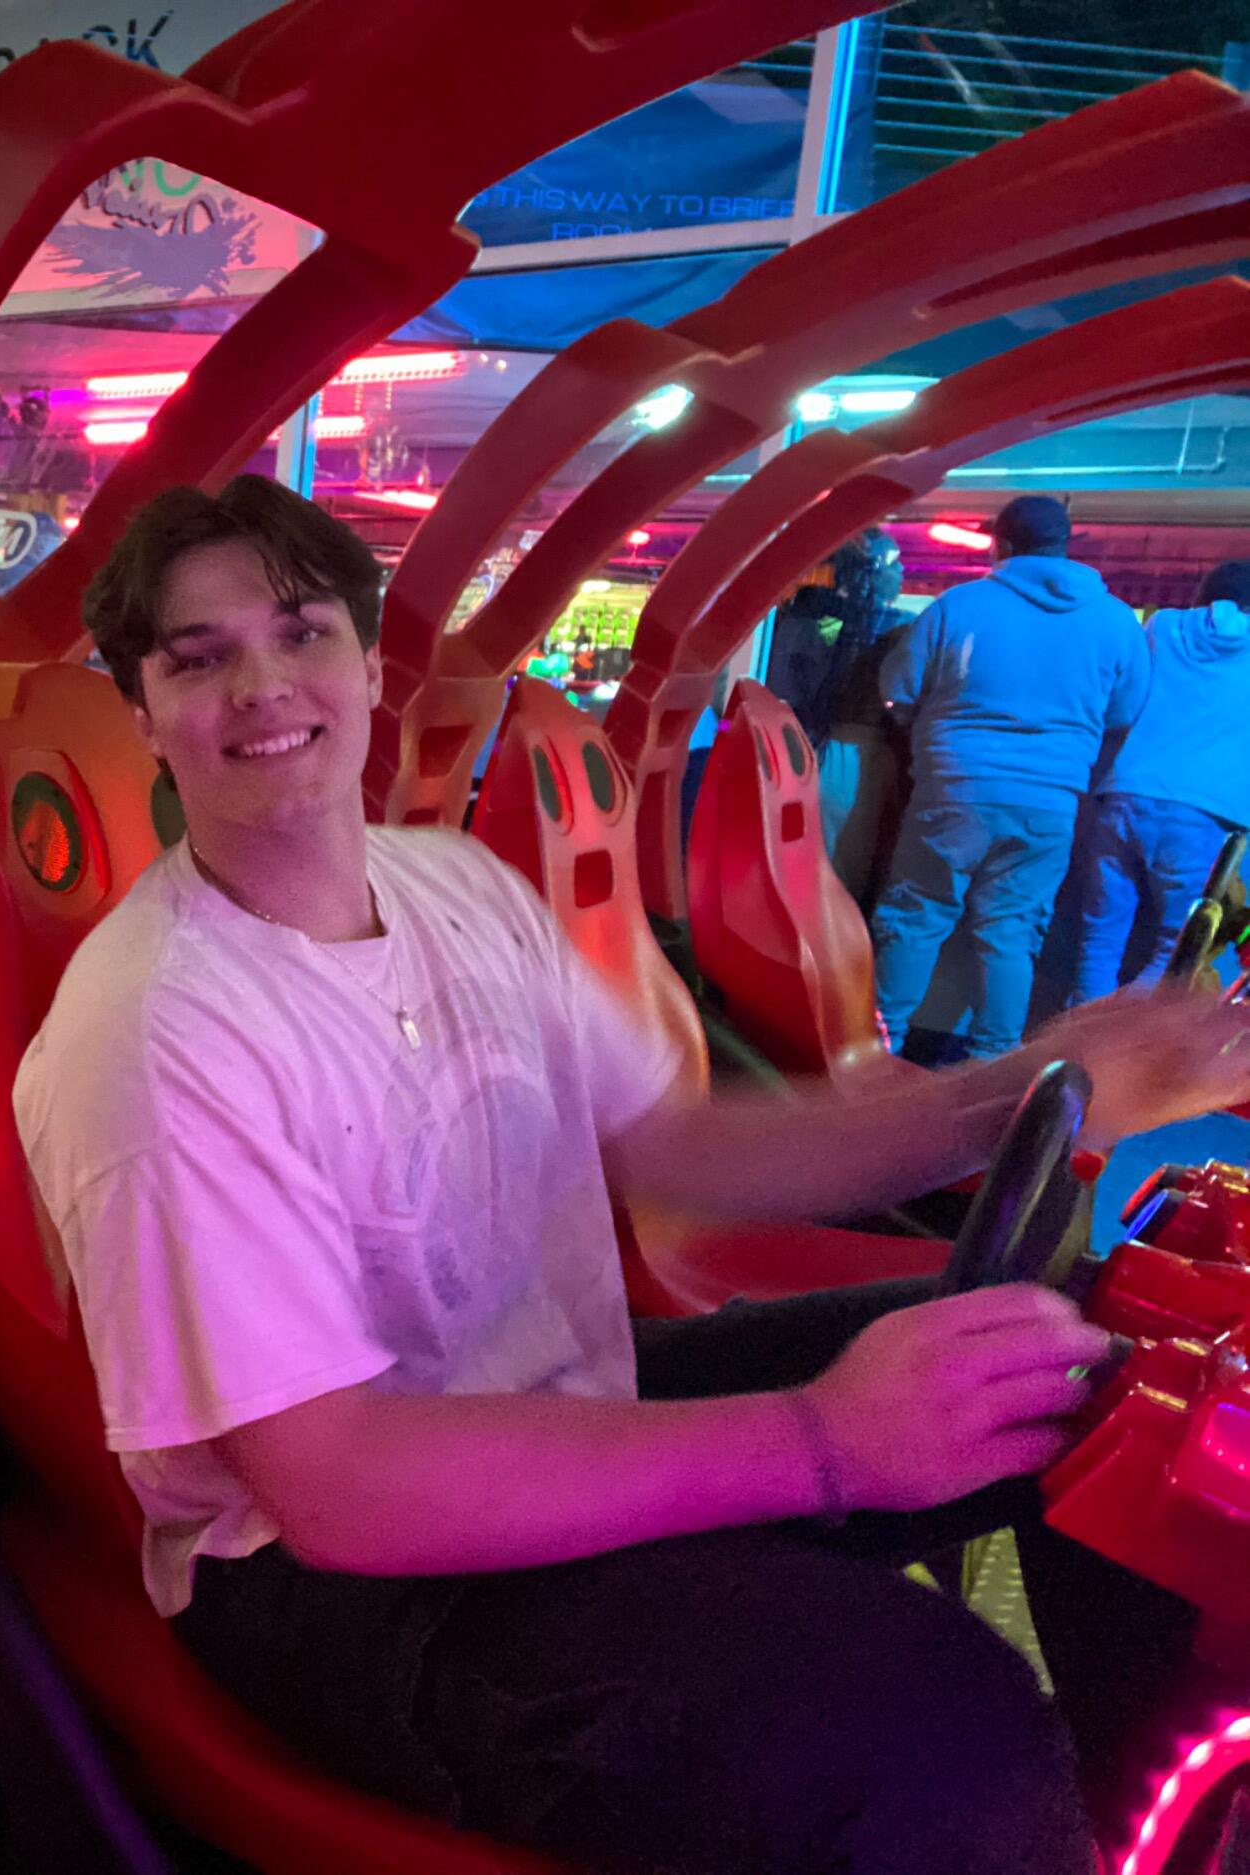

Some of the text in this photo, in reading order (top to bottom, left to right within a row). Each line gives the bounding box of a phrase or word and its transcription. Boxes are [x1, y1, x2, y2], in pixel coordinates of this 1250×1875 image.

[494, 185, 566, 210] THIS
[571, 190, 651, 214] WAY
[658, 194, 704, 217] TO
